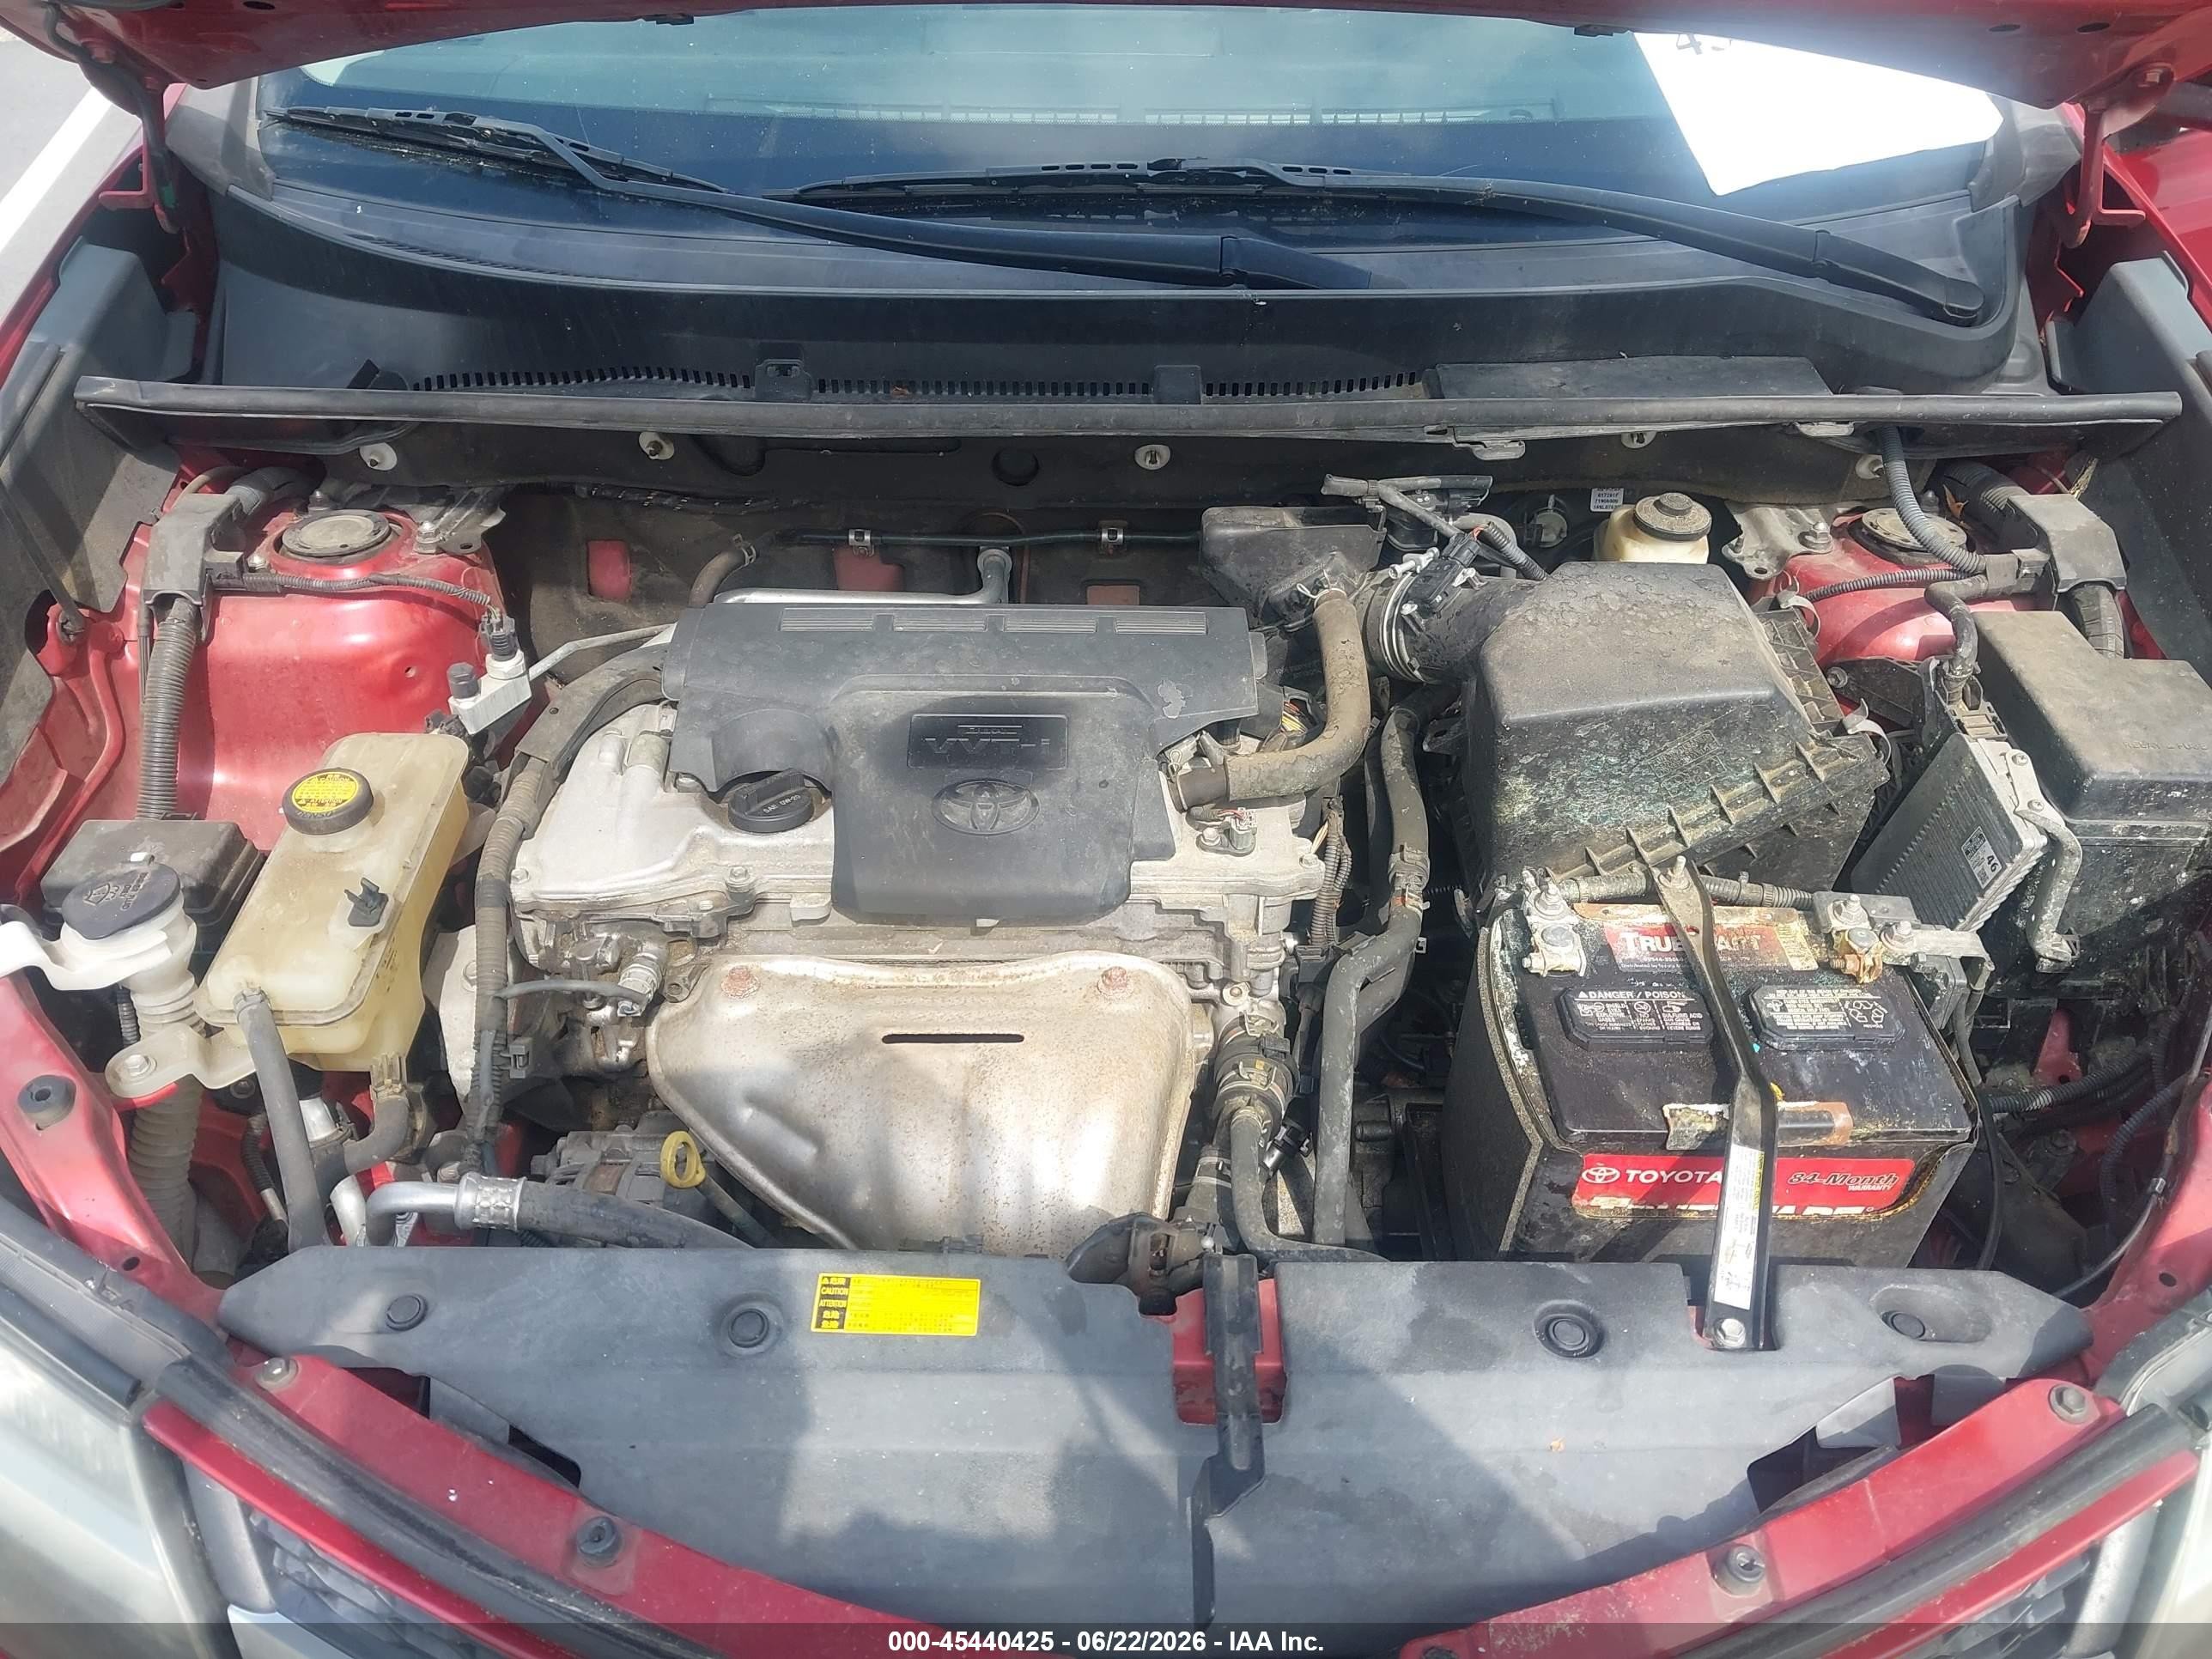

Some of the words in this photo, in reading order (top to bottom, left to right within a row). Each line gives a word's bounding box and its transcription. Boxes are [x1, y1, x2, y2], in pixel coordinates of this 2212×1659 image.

[763, 803, 778, 814] SAE
[1626, 1170, 1723, 1184] TOYOTA
[1789, 1171, 1899, 1186] 84-Month
